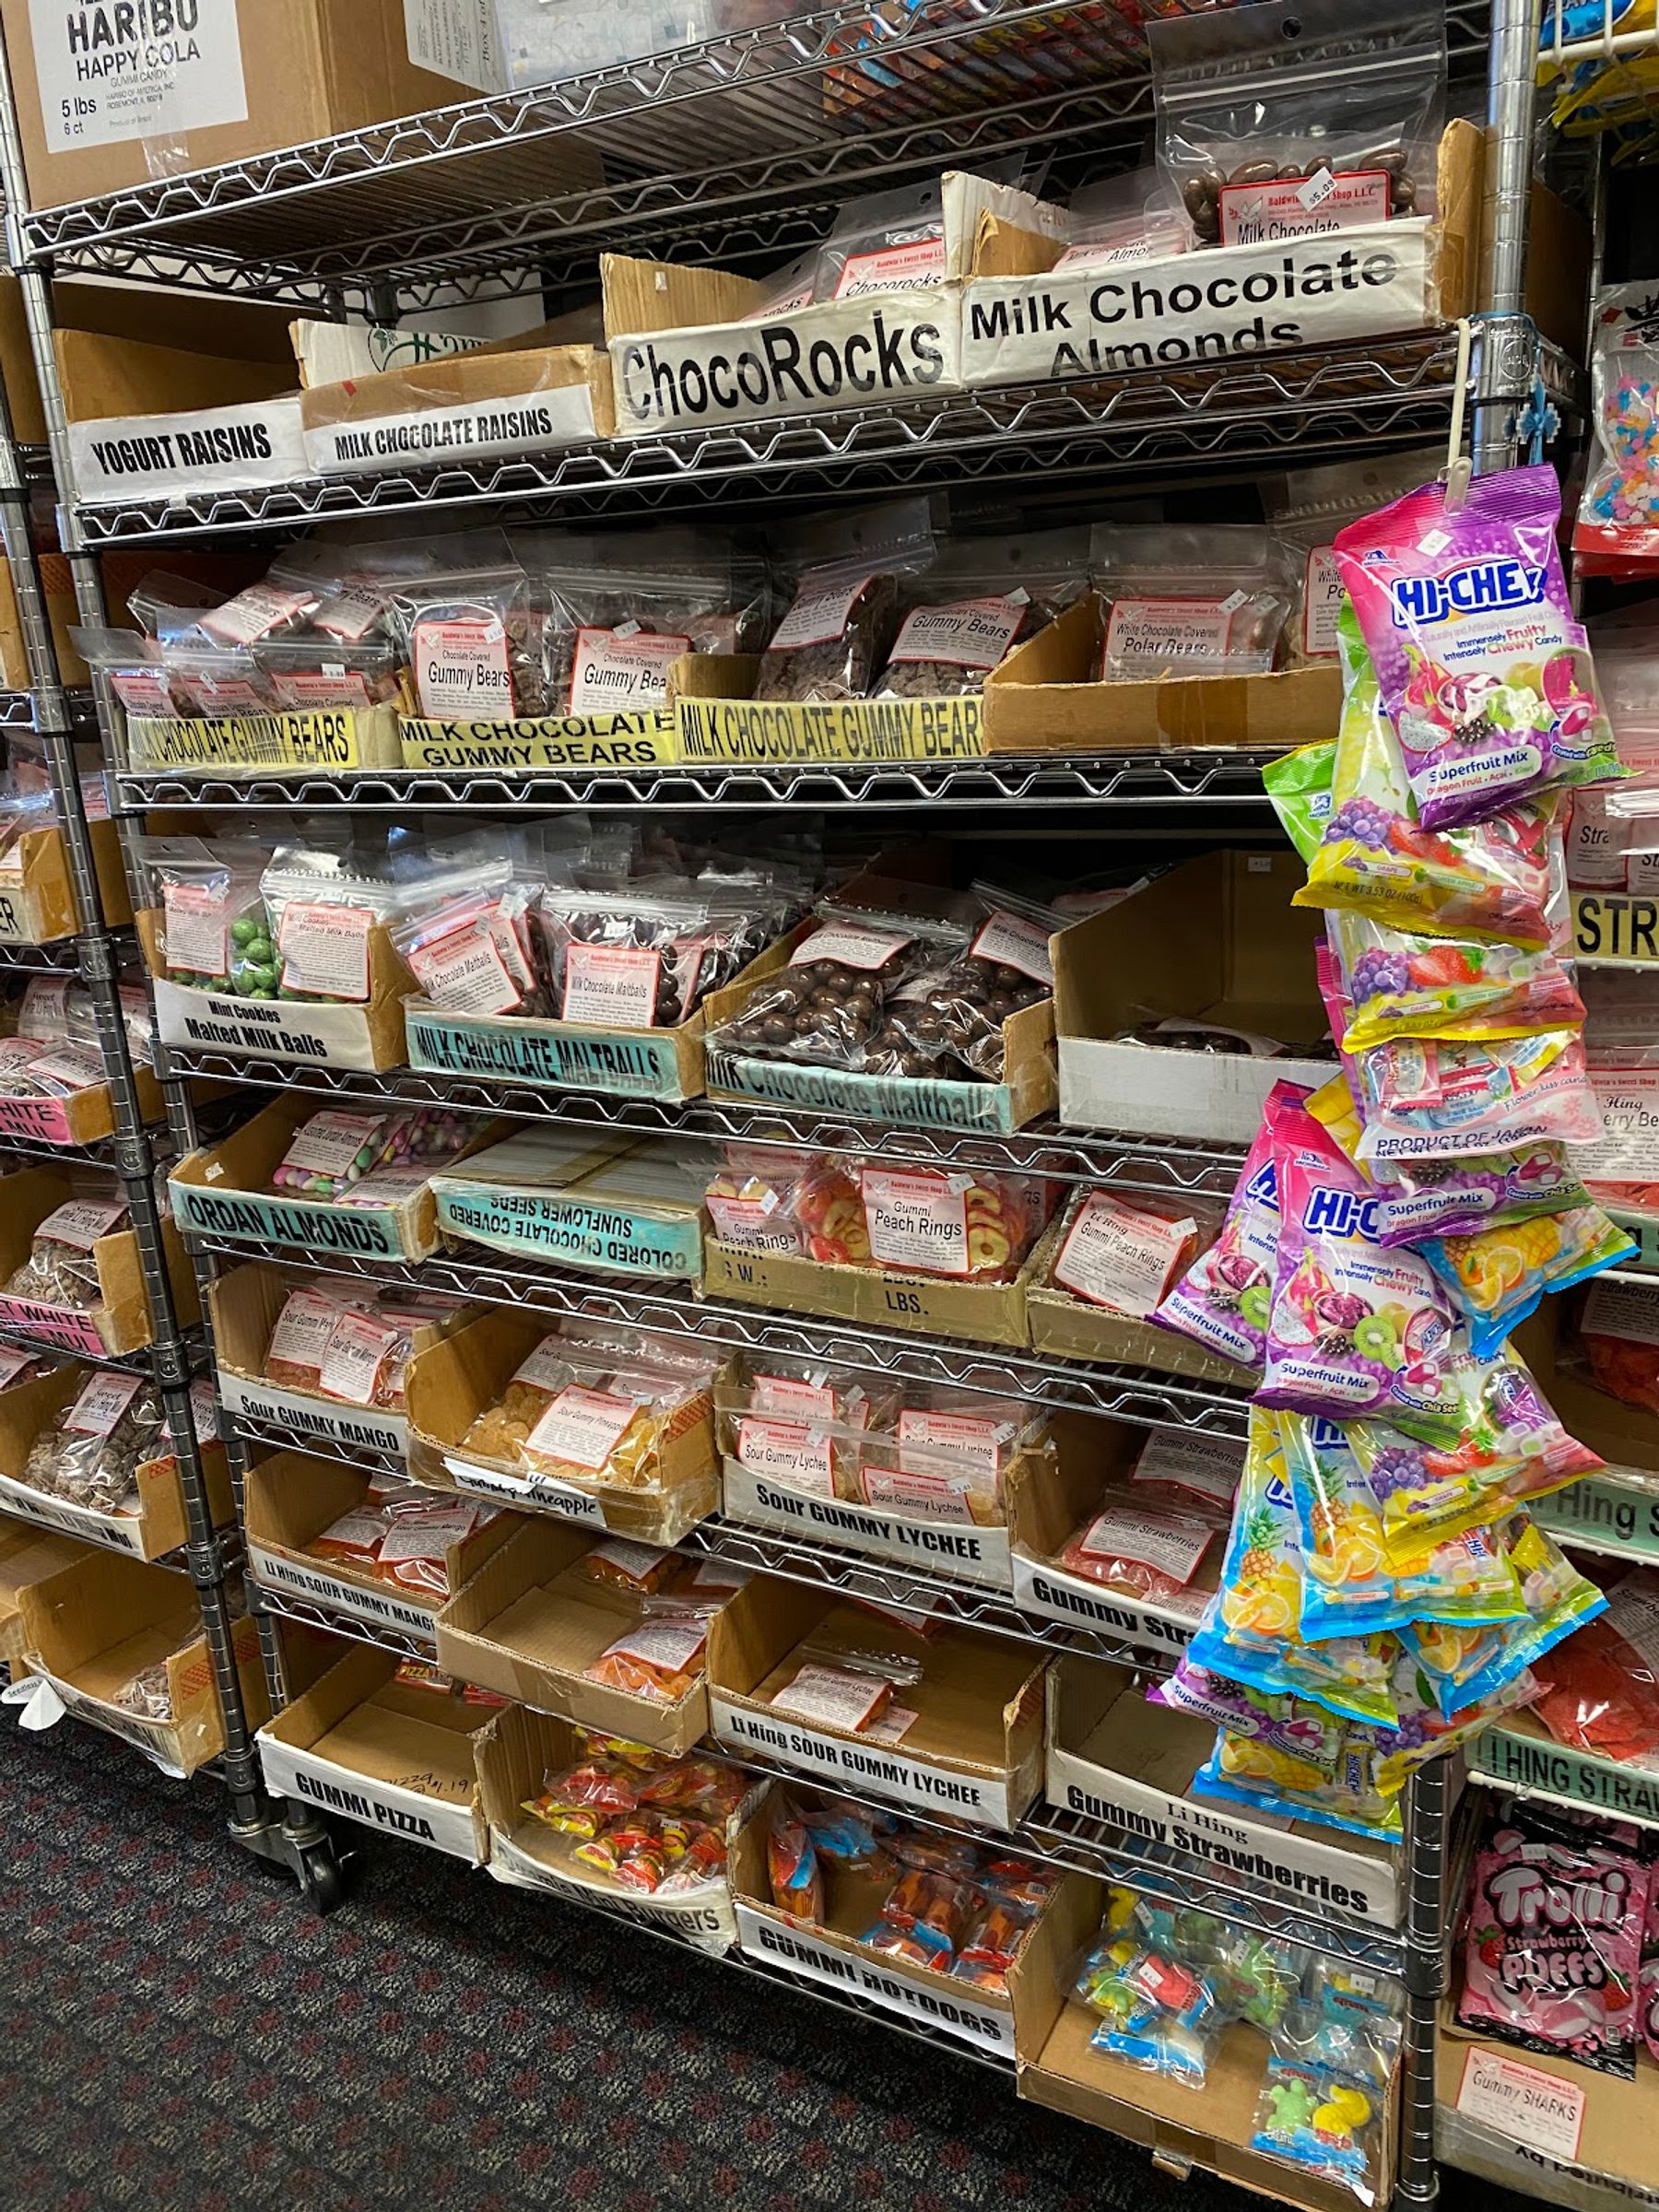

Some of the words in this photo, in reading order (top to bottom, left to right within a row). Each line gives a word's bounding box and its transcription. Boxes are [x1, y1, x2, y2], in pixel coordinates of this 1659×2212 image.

[76, 50, 138, 81] HAPPY
[146, 38, 201, 67] COLA
[111, 74, 138, 88] GUMMI
[139, 69, 168, 83] CANDY
[62, 100, 70, 118] 5
[75, 97, 97, 115] lbs
[64, 123, 70, 135] 6
[74, 121, 83, 134] ct
[1332, 189, 1352, 200] Shop
[1238, 220, 1265, 244] Milk
[1268, 218, 1340, 241] Chocolate
[971, 294, 1073, 339] Milk
[1089, 250, 1397, 324] Chocolate
[1050, 318, 1303, 377] Almonds
[622, 310, 945, 419] ChocoRocks
[335, 435, 372, 461] MILK
[376, 418, 472, 457] CHOCOLATE
[477, 407, 553, 441] RAISINS
[90, 436, 172, 476] YOGURT
[177, 423, 272, 468] RAISINS
[912, 614, 965, 632] Gummy
[967, 613, 1010, 640] Bears
[1140, 623, 1183, 637] Chocolate
[1184, 625, 1219, 638] Covered
[1456, 634, 1506, 649] Immensely
[1506, 624, 1547, 641] Fruity
[442, 650, 467, 661] Chocolate
[469, 650, 490, 662] Covered
[604, 653, 635, 665] Chocolate
[636, 656, 663, 668] Covered
[1123, 638, 1161, 654] Polar
[1443, 647, 1486, 661] Intensely
[1486, 639, 1535, 655] Chewy
[1535, 635, 1562, 647] Candy
[428, 661, 473, 691] Gummy
[477, 664, 510, 688] Bears
[584, 664, 638, 693] Gummy
[641, 667, 666, 689] Bea
[160, 717, 230, 762] CHOCOLATE
[231, 714, 288, 764] GUMMY
[288, 712, 349, 763] BEARS
[399, 721, 464, 742] MILK
[470, 710, 675, 740] CHOCOLATE
[680, 703, 725, 757] MILK
[724, 705, 841, 758] CHOCOLATE
[841, 703, 917, 758] GUMMY
[921, 700, 983, 757] BEAR
[423, 746, 531, 767] GUMMY
[545, 741, 657, 765] BEARS
[1430, 756, 1501, 782] Superfruit
[1503, 751, 1528, 766] Mix
[1462, 776, 1482, 787] Fruit
[1008, 928, 1048, 951] Chocolate
[1577, 897, 1659, 957] STR
[583, 977, 615, 994] Chocolate
[208, 1000, 231, 1018] Mint
[234, 1004, 281, 1023] Cookies
[185, 1018, 242, 1046] Malted
[243, 1026, 282, 1051] Milk
[283, 1031, 328, 1057] Balls
[416, 1026, 451, 1064] MILK
[453, 1031, 559, 1080] CHOCOLATE
[0, 1100, 56, 1122] HITE
[877, 1077, 1002, 1131] Maltballs
[1504, 1088, 1538, 1112] Flower
[1604, 1097, 1643, 1112] Hing
[1377, 1135, 1463, 1150] PRODUCT
[1465, 1133, 1488, 1144] OF
[450, 1203, 510, 1234] COVERED
[490, 1195, 536, 1217] SEEDS
[542, 1199, 633, 1238] SUNFLOWER
[893, 1200, 932, 1218] Gummi
[1303, 1185, 1380, 1238] HI-C
[1387, 1196, 1457, 1217] Superfruit
[1458, 1192, 1484, 1204] Mix
[186, 1194, 269, 1237] ORDAN
[268, 1206, 389, 1254] ALMONDS
[514, 1220, 603, 1256] CHOCOLATE
[734, 1223, 763, 1235] Gummi
[875, 1209, 917, 1236] Peach
[918, 1217, 963, 1241] Rings
[756, 1231, 796, 1250] Rings
[1080, 1221, 1112, 1243] Gummi
[1111, 1236, 1136, 1259] Peach
[1138, 1244, 1166, 1272] Rings
[608, 1241, 688, 1270] COLORED
[1350, 1260, 1394, 1278] Immensely
[1394, 1269, 1425, 1287] Fruity
[1373, 1274, 1415, 1297] Chewy
[886, 1290, 929, 1315] LBS.
[1599, 1281, 1659, 1301] Strawberry
[18, 1304, 95, 1333] WHITE
[282, 1309, 297, 1323] Sour
[1171, 1297, 1223, 1339] Superfruit
[1222, 1330, 1247, 1350] Mix
[1281, 1362, 1346, 1386] Superfruit
[1347, 1375, 1371, 1390] Mix
[241, 1394, 276, 1419] Sour
[278, 1406, 336, 1436] GUMMY
[338, 1421, 400, 1452] MANGO
[558, 1406, 573, 1418] Sour
[746, 1444, 765, 1461] Sour
[766, 1450, 798, 1469] Gummy
[799, 1452, 828, 1472] Lychee
[1154, 1434, 1186, 1453] Gummi
[1186, 1441, 1244, 1469] Strawberries
[526, 1487, 596, 1515] ineapple
[872, 1489, 893, 1503] Sour
[894, 1495, 929, 1514] Gummy
[930, 1499, 964, 1515] Lychee
[1558, 1483, 1636, 1539] Hing
[756, 1483, 805, 1516] Sour
[809, 1501, 891, 1540] GUMMY
[897, 1525, 982, 1560] LYCHEE
[1104, 1516, 1138, 1533] Gummi
[1139, 1522, 1200, 1552] Strawberries
[276, 1564, 308, 1590] Hing
[307, 1576, 341, 1599] SOUR
[342, 1588, 390, 1617] GUMMY
[1032, 1577, 1139, 1634] Gummy
[399, 1665, 430, 1678] PIZZA
[1173, 1684, 1230, 1721] Superfruit
[1229, 1711, 1251, 1727] Mix
[730, 1715, 746, 1734] Li
[747, 1722, 787, 1749] Hing
[790, 1735, 839, 1764] SOUR
[841, 1750, 909, 1787] GUMMY
[913, 1772, 981, 1806] LYCHEE
[1506, 1742, 1570, 1792] HING
[295, 1771, 371, 1819] GUMMI
[373, 1802, 436, 1842] PIZZA
[1166, 1802, 1189, 1822] Li
[1194, 1811, 1249, 1845] Hing
[1067, 1784, 1166, 1842] Gummy
[1172, 1824, 1369, 1913] Strawberries
[1489, 1867, 1630, 1927] Trolli
[629, 1906, 720, 1936] Burgers
[1507, 1935, 1587, 1950] Strawberry
[758, 1924, 857, 1983] GUMMI
[863, 1971, 1003, 2041] HOTDOGS
[1501, 1952, 1607, 1993] PUFFS
[1473, 2071, 1521, 2102] Gummy
[1524, 2088, 1577, 2122] SHARKS
[1515, 2147, 1545, 2167] by
